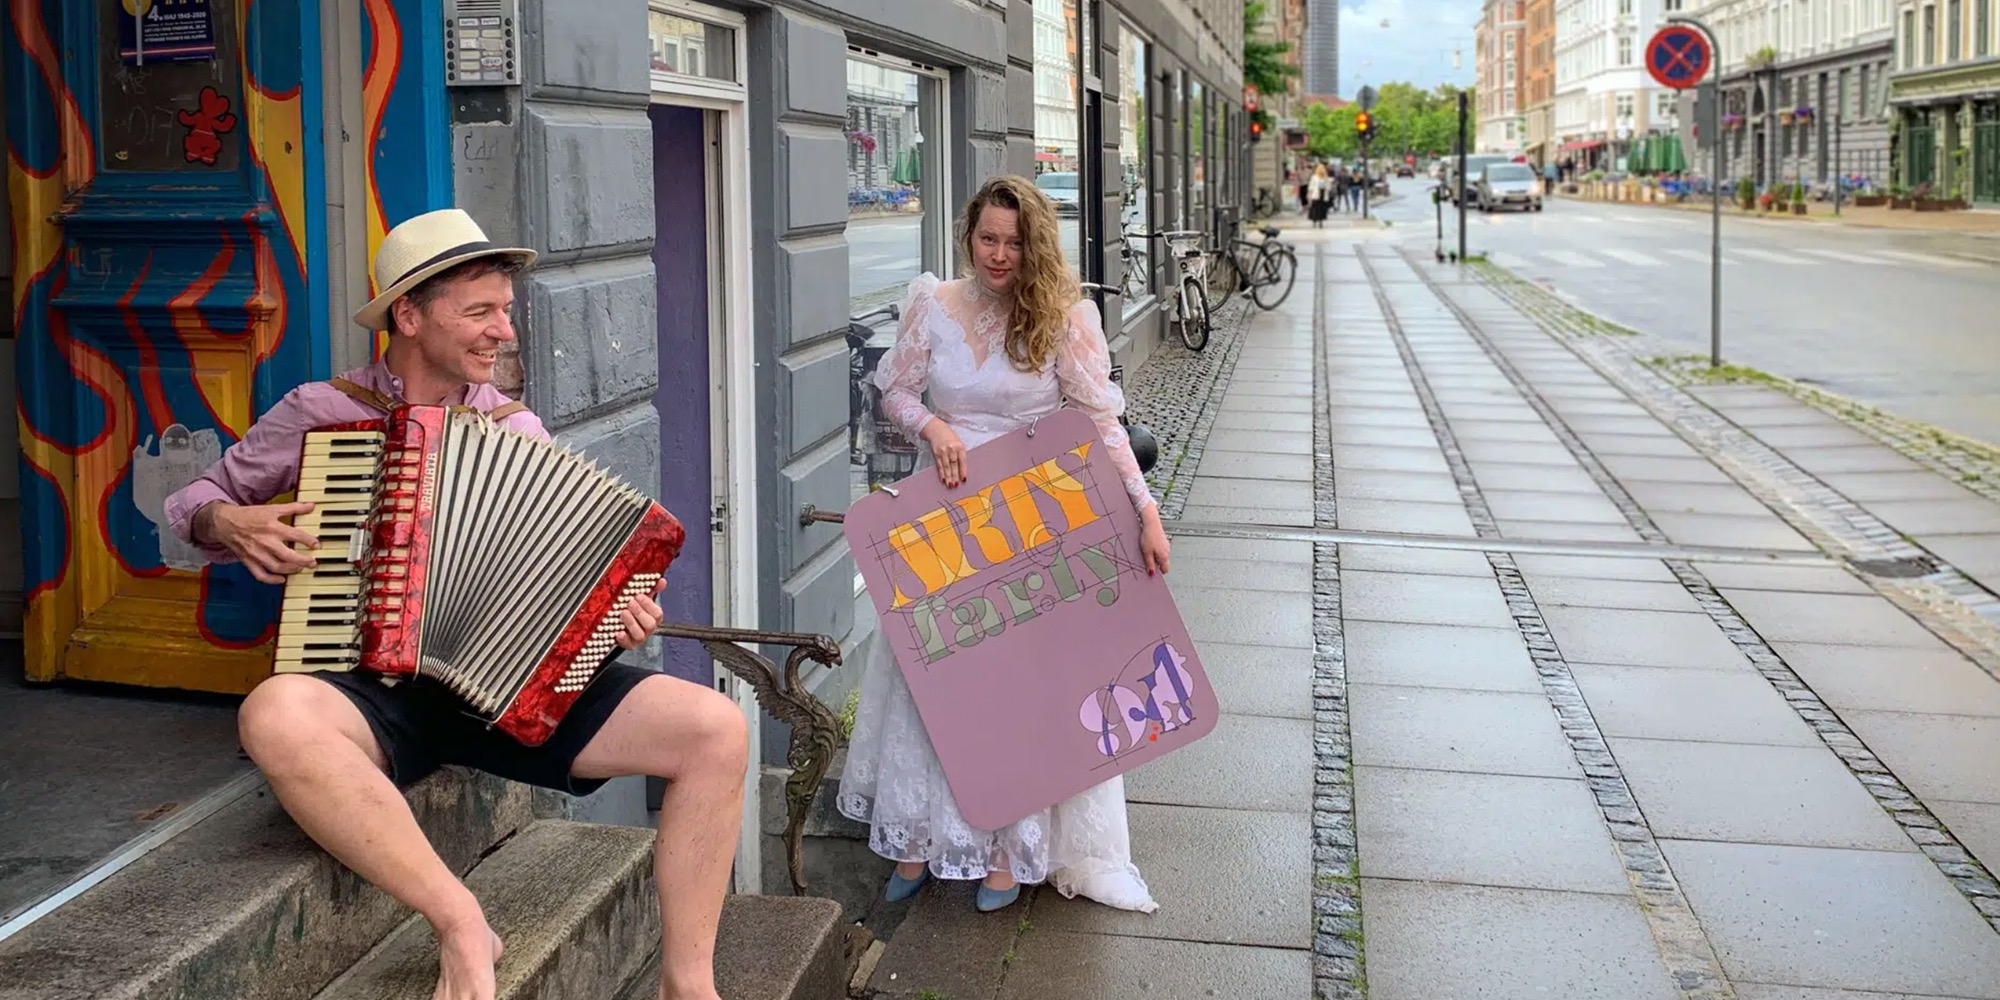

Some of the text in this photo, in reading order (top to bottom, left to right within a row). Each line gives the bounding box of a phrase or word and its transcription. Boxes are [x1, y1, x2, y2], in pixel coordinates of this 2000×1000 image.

[420, 451, 438, 512] TRAVIATA
[889, 440, 1103, 611] ARTY
[909, 535, 1121, 665] farty
